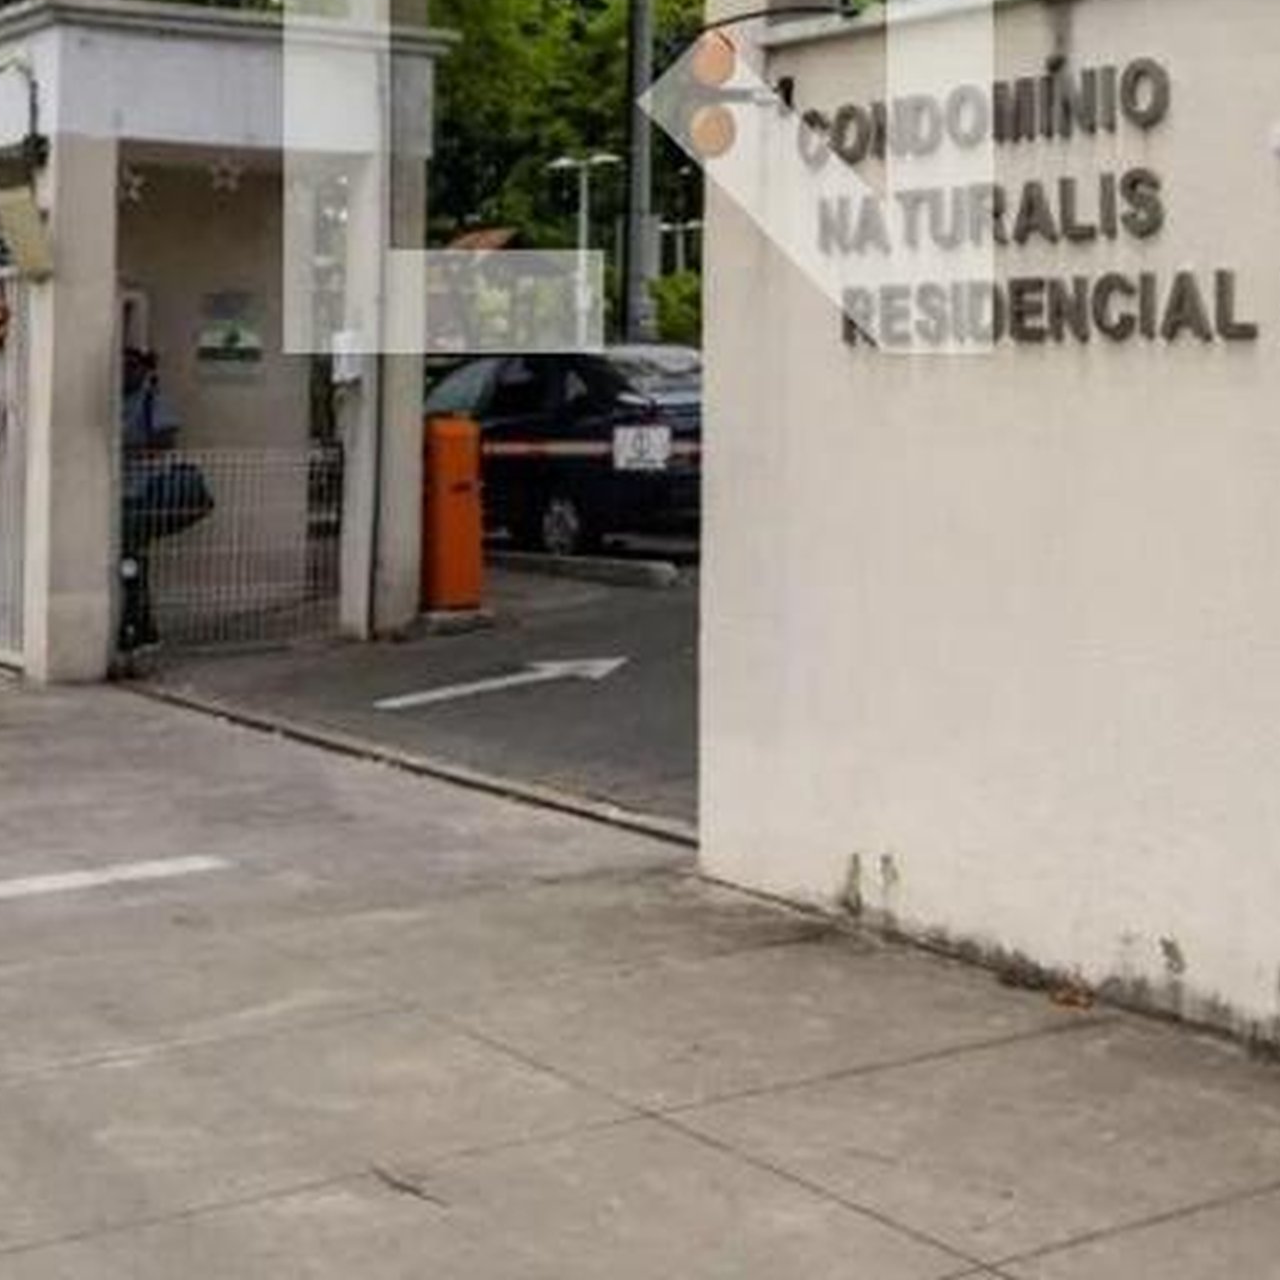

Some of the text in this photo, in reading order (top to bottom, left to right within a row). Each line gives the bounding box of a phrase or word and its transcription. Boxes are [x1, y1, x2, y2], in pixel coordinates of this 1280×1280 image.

[797, 55, 1171, 169] CONDOMÍNIO
[818, 167, 1166, 256] NATURALIS
[841, 269, 1259, 348] RESIDENCIAL
